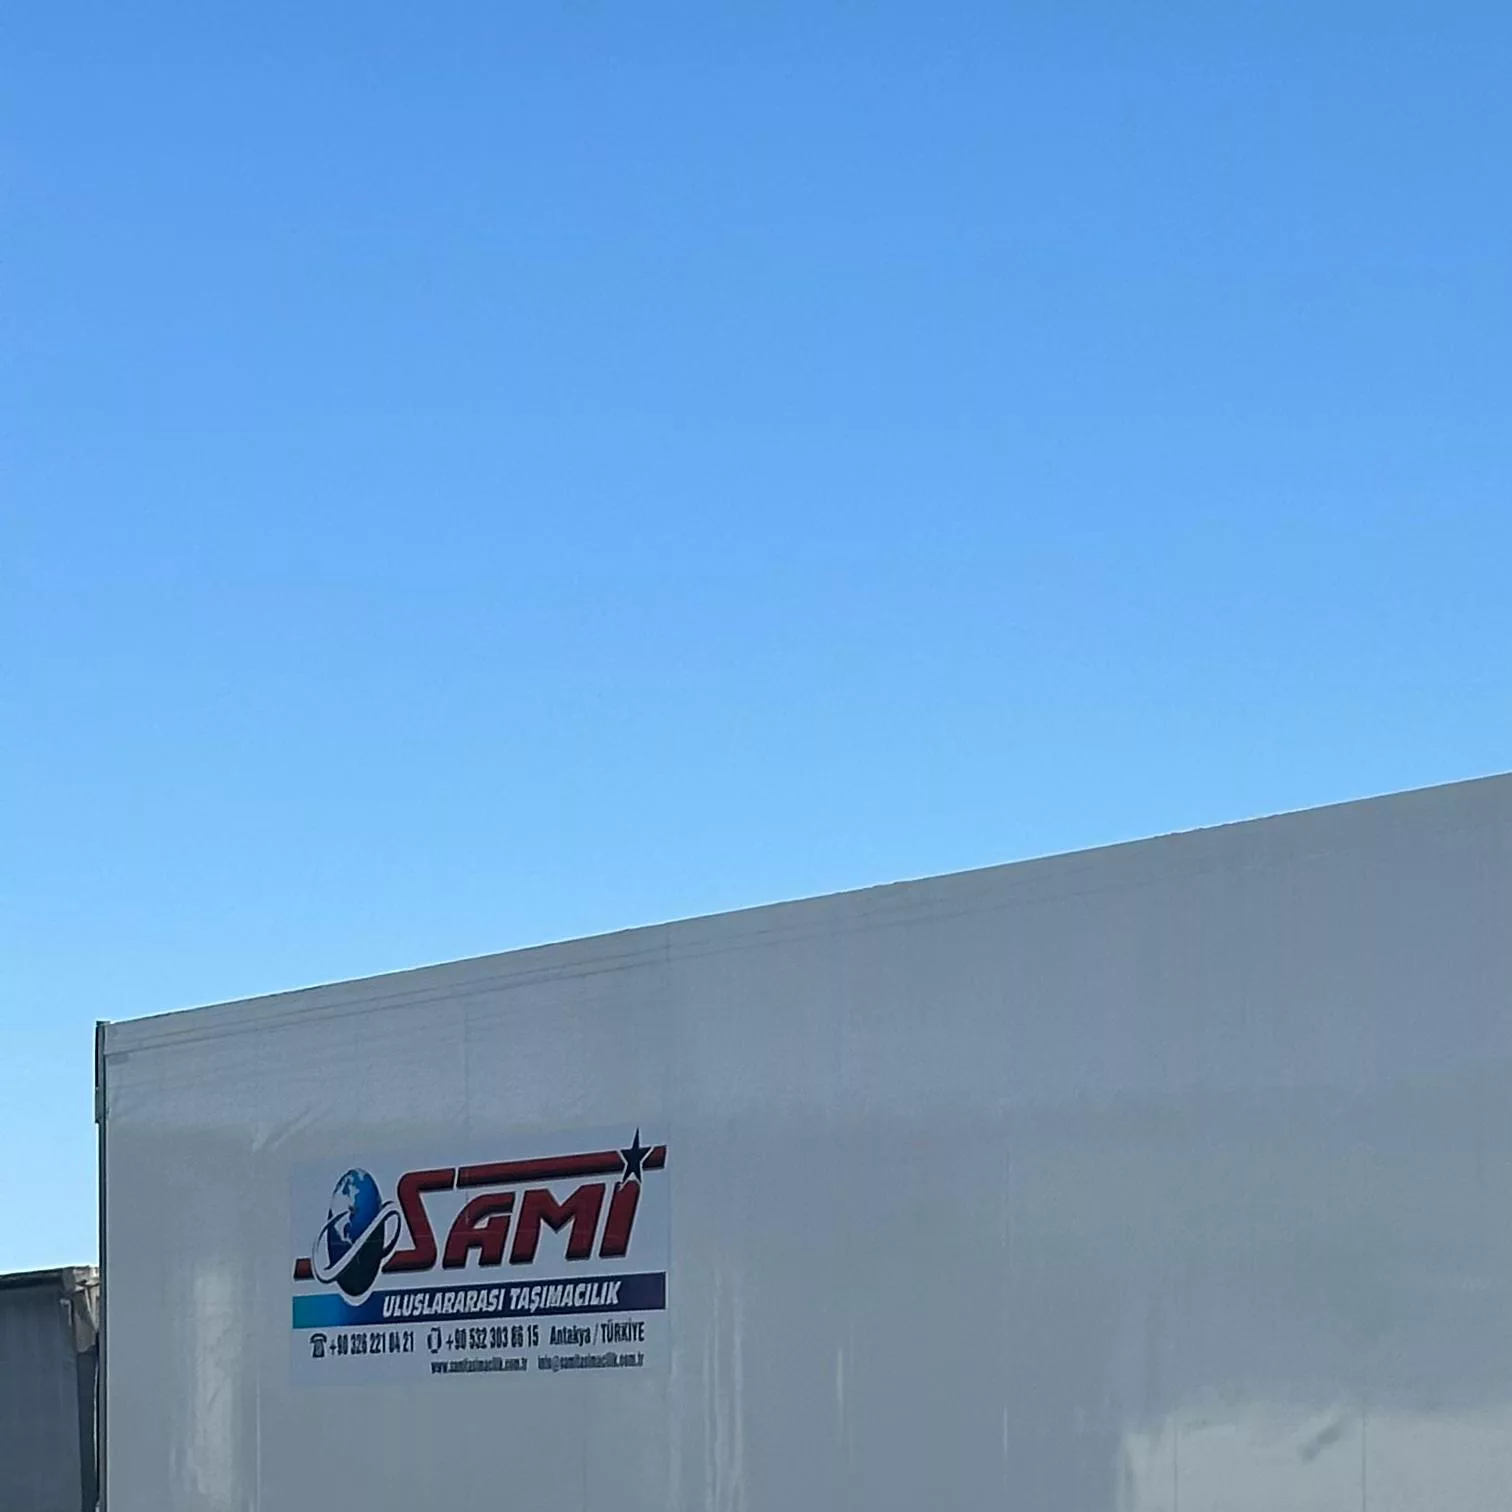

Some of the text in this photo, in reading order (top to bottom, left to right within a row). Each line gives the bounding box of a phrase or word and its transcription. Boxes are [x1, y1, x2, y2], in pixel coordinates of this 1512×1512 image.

[382, 1281, 622, 1318] ULUSLARARASI TAŞIMACILIK
[369, 1331, 387, 1354] 221
[402, 1330, 415, 1353] 21
[445, 1328, 467, 1351] +90
[468, 1326, 488, 1350] 532
[489, 1325, 509, 1349] 303
[527, 1324, 539, 1348] 15
[549, 1325, 591, 1347] Antakya
